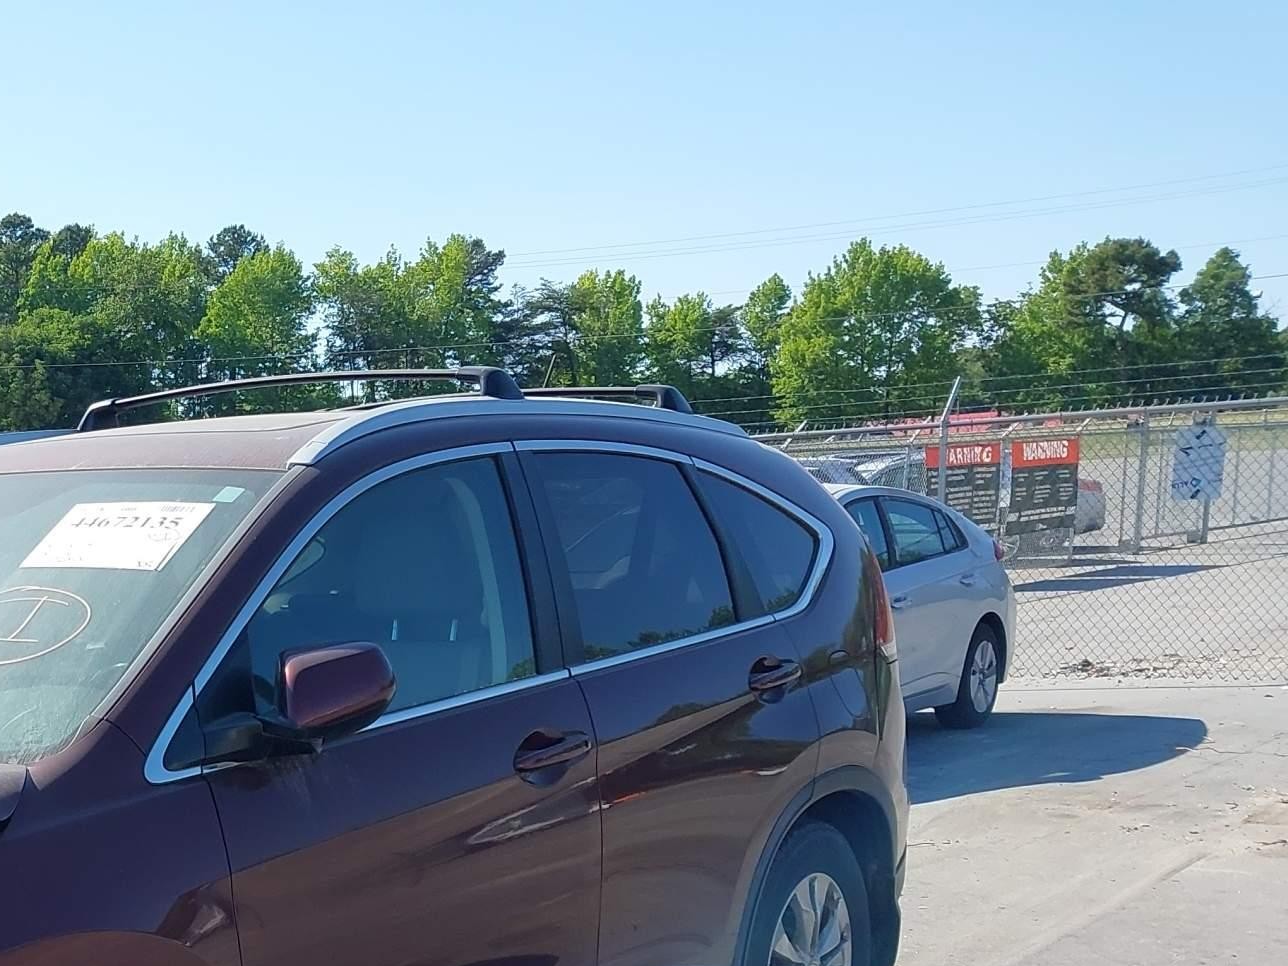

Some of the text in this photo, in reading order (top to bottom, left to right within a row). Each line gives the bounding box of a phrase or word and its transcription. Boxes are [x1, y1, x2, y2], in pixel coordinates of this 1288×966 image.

[946, 446, 992, 464] ARNING
[1023, 440, 1069, 461] WARNING
[72, 516, 184, 530] 44672135
